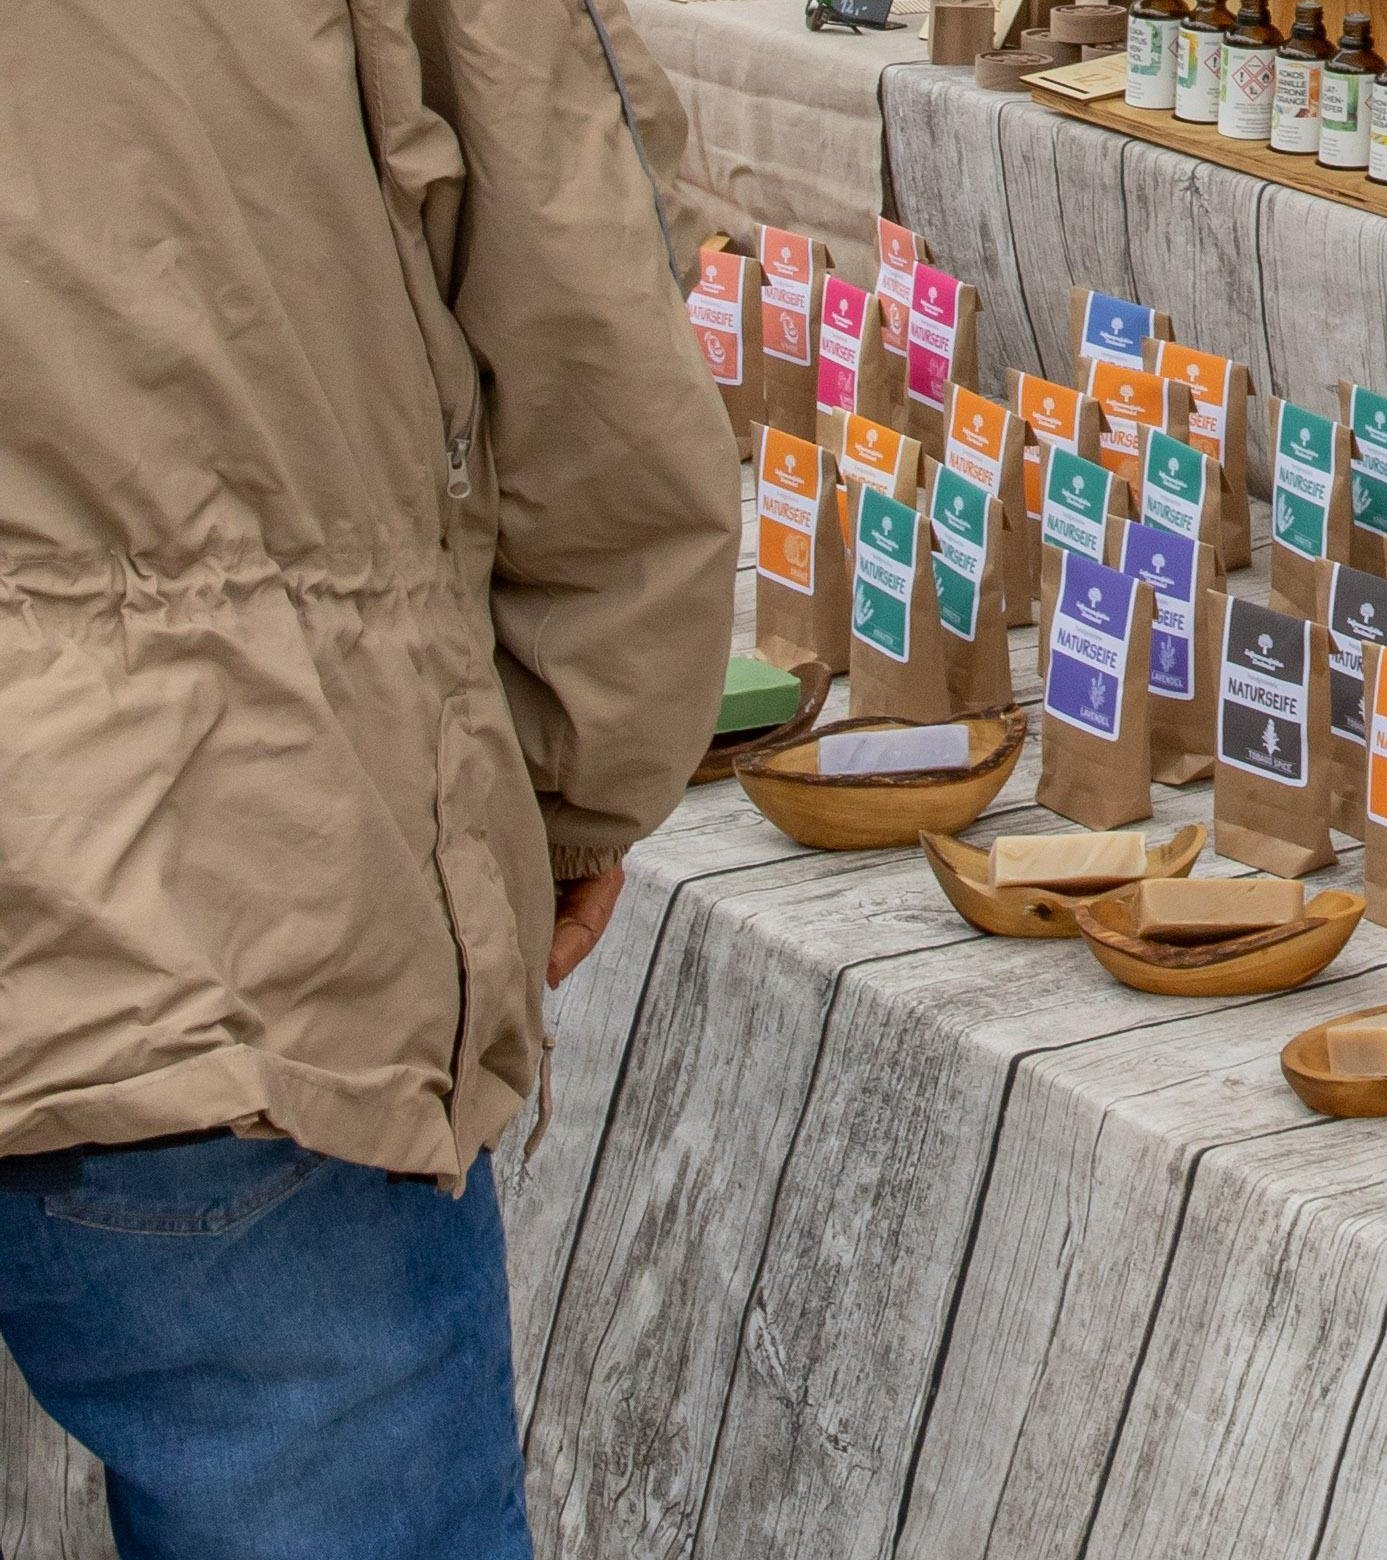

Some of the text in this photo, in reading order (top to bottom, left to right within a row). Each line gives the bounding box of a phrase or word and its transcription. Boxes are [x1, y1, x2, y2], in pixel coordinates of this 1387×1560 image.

[763, 285, 807, 310] NATURSEIFE
[822, 338, 856, 366] NATURSEIFE
[911, 321, 950, 354] NATURSEIFE
[949, 452, 994, 488] NATURSEIFE
[1279, 465, 1326, 501] NATURSEIFE
[762, 493, 812, 530] NATURSEIFE
[1147, 494, 1193, 533] NATURSEIFE
[1047, 512, 1097, 551] NATURSEIFE
[859, 553, 907, 596] NATURSEIFE
[1056, 627, 1118, 670] NATURSEIFE
[1227, 677, 1298, 716] NATURSEIFE
